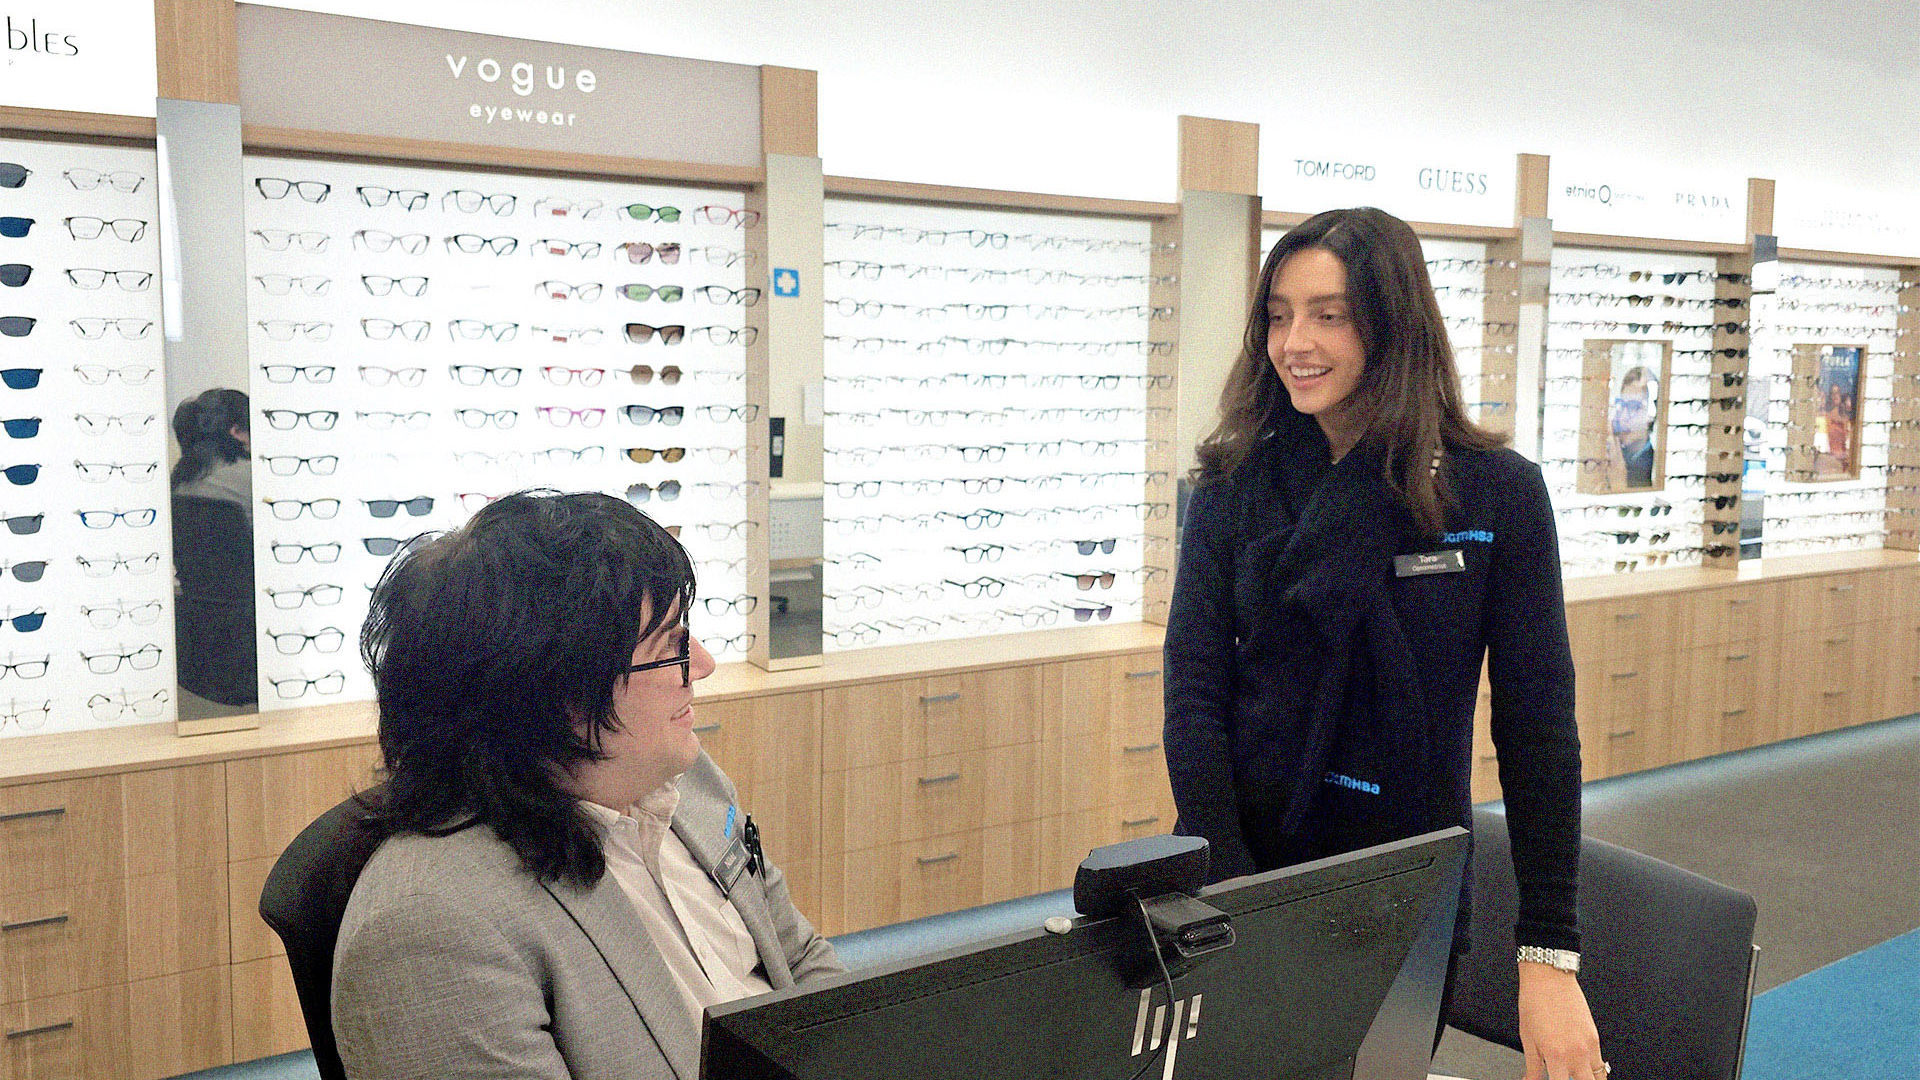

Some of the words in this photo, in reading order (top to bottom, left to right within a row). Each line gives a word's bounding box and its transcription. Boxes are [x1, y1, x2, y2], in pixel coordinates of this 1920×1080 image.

[445, 53, 598, 97] vogue
[469, 103, 576, 127] eyewear
[1294, 159, 1330, 177] TOM
[1333, 161, 1376, 182] FORD
[1418, 167, 1488, 196] GUESS
[1565, 181, 1597, 200] etnia
[1675, 192, 1731, 209] PRADA
